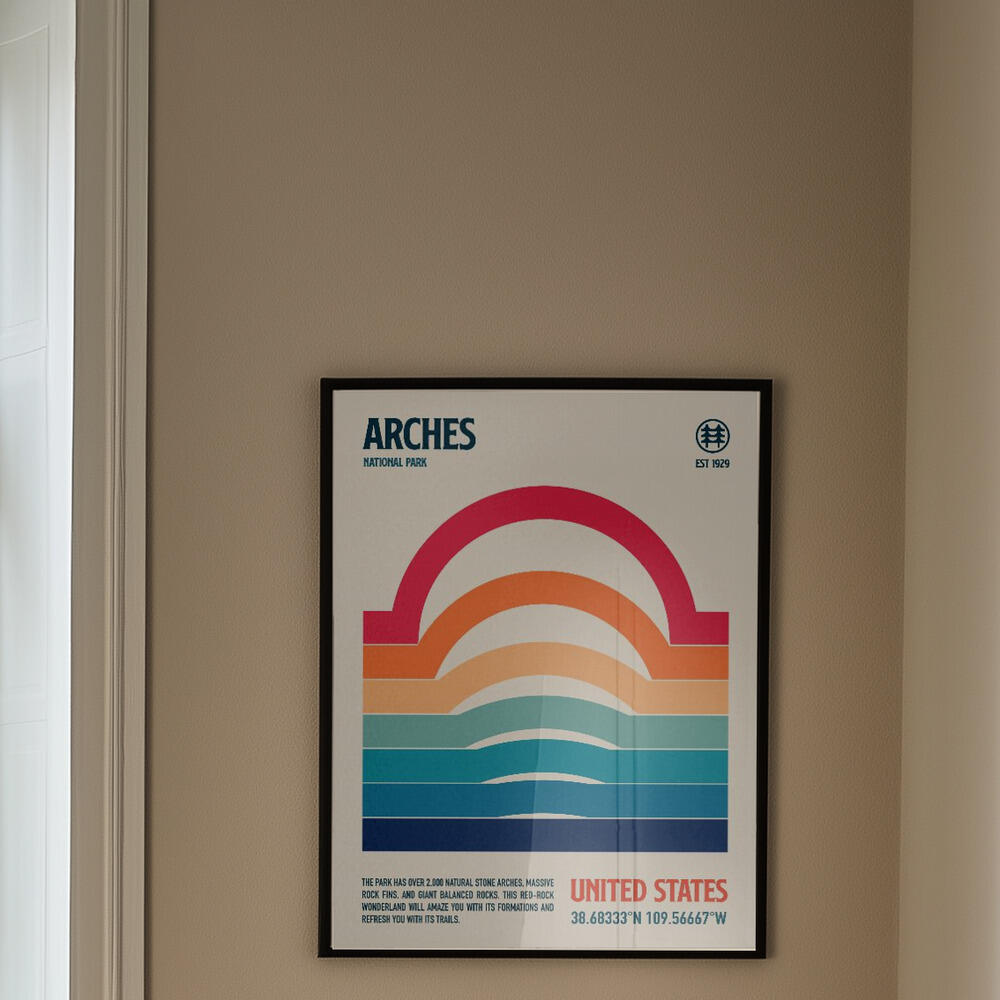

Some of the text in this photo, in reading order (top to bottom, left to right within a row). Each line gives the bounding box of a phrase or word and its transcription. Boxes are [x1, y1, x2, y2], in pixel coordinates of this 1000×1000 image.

[363, 417, 476, 450] ARCHES
[363, 457, 427, 468] NATIONAL PARK
[696, 458, 730, 468] EST 1929
[361, 878, 374, 887] THE
[375, 878, 392, 887] PARK
[394, 878, 407, 887] HAS
[408, 878, 425, 887] OVER
[445, 878, 473, 887] NATURAL
[475, 878, 496, 887] STONE
[526, 878, 554, 887] MASSIVE
[362, 890, 379, 899] ROCK
[402, 890, 415, 899] AND
[418, 890, 437, 899] GIANT
[440, 890, 473, 899] BALANCED
[503, 890, 517, 899] THIS
[520, 890, 554, 900] RED-ROCK
[571, 879, 728, 903] UNITED STATES
[362, 902, 554, 912] WONDERLAND WILL AMAZE YOU WITH ITS FORMATIONS AND
[362, 915, 460, 924] REFRESH YOU WITH ITS TRAILS.
